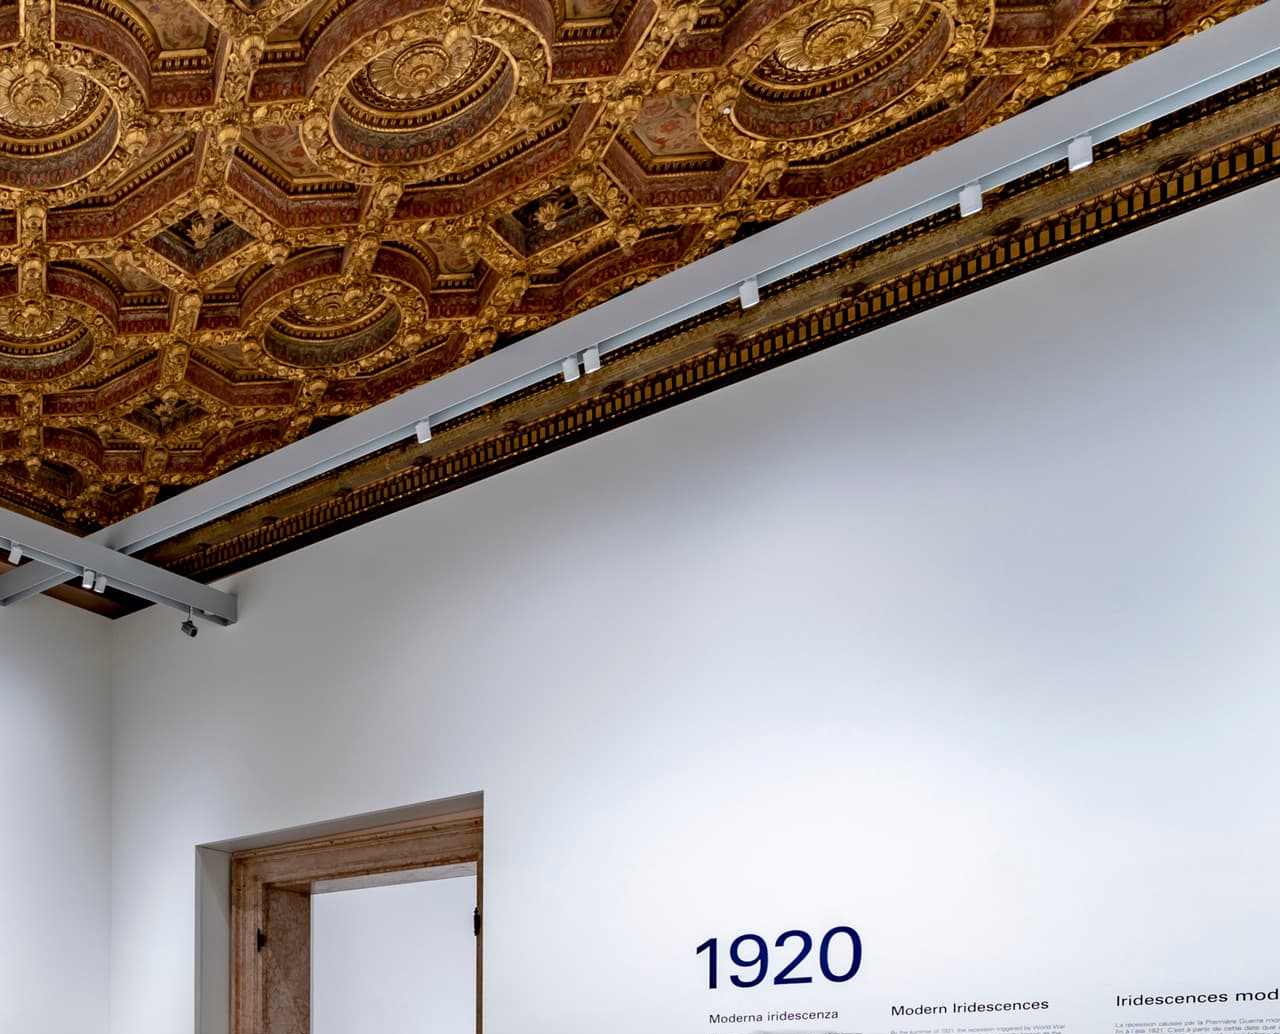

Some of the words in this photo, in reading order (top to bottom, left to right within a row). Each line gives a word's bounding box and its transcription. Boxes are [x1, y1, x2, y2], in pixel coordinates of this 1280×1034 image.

[696, 926, 862, 989] 1920
[1116, 993, 1228, 1007] Iridescences
[1235, 988, 1279, 1002] mod
[709, 1013, 763, 1025] Moderna
[767, 1010, 838, 1022] iridescenza
[891, 1004, 948, 1017] Modern
[953, 1000, 1049, 1014] Iridescences
